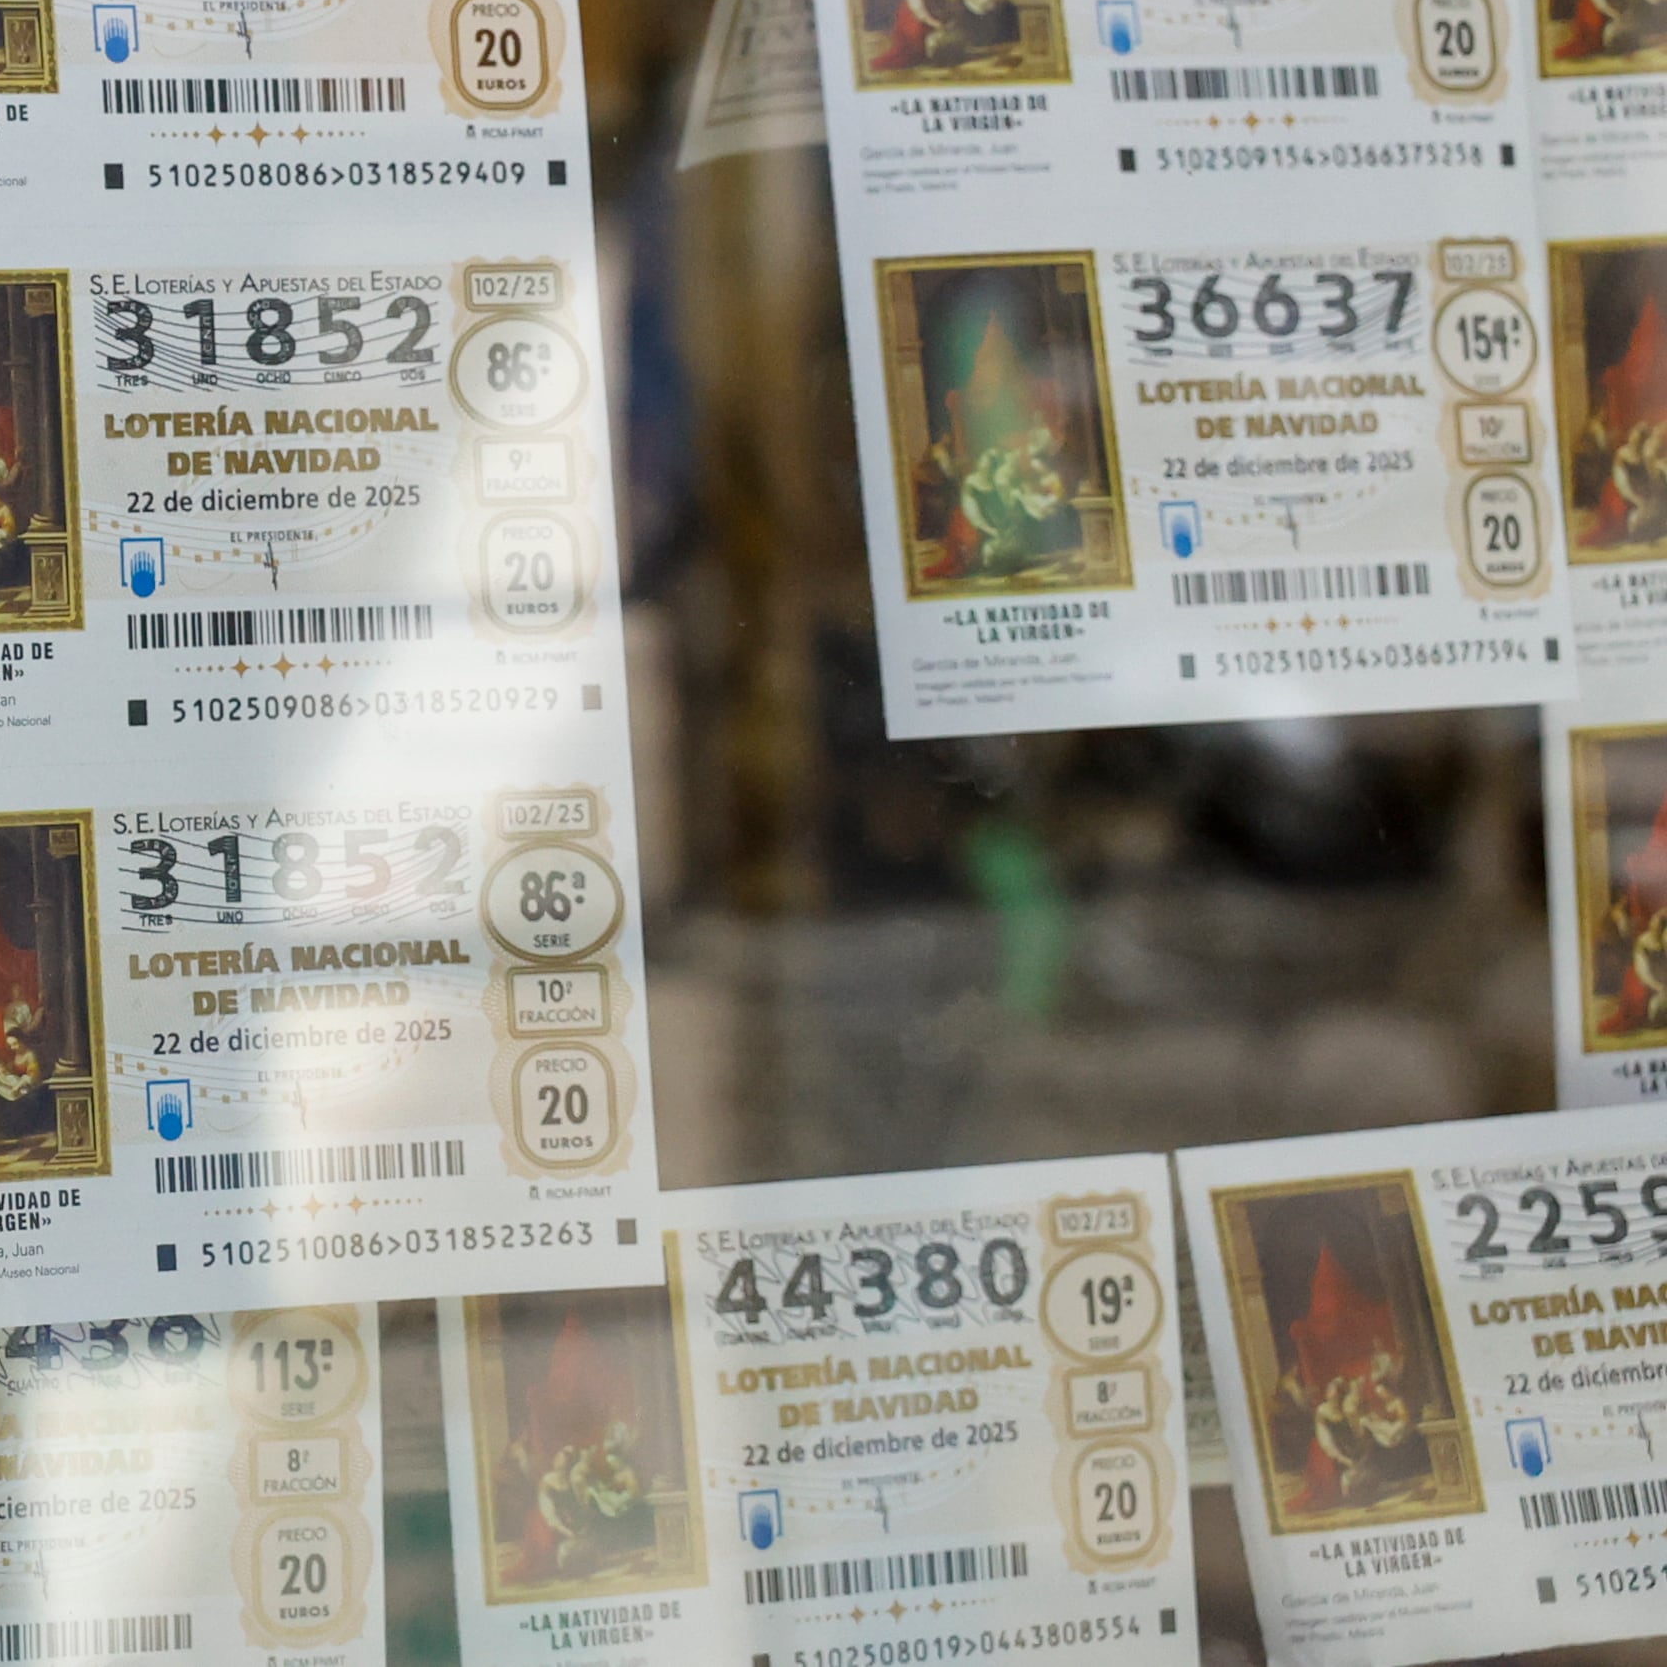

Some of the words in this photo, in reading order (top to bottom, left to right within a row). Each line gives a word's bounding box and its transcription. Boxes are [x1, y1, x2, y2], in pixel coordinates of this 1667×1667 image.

[473, 28, 523, 68] 20
[1433, 19, 1477, 57] 20
[147, 159, 528, 189] 5102508086>0318529409
[1134, 271, 1416, 343] 36637
[106, 297, 436, 372] 31852
[1134, 374, 1270, 404] LOTERÍA
[1277, 374, 1426, 401] NACIONAL
[103, 404, 254, 440] LOTERÍA
[263, 406, 441, 436] NACIONAL
[1193, 415, 1236, 440] DE
[1244, 414, 1379, 438] NAVIDAD
[166, 451, 213, 478] DE
[222, 446, 382, 477] NAVIDAD
[1483, 515, 1521, 550] 20
[504, 551, 553, 593] 20
[129, 826, 466, 910] 31852
[127, 940, 281, 981] LOTERÍA
[289, 937, 471, 972] NACIONAL
[192, 988, 240, 1018] DE
[248, 979, 412, 1014] NAVIDAD
[537, 1083, 589, 1127] 20
[201, 1221, 594, 1268] 5102510086>0318523263
[715, 1238, 1029, 1325] 44380
[716, 1353, 859, 1396] LOTERÍA
[867, 1343, 1033, 1382] NACIONAL
[1571, 1360, 1667, 1390] diciembr
[777, 1401, 823, 1431] DE
[830, 1386, 980, 1424] NAVIDAD
[1093, 1480, 1139, 1523] 20
